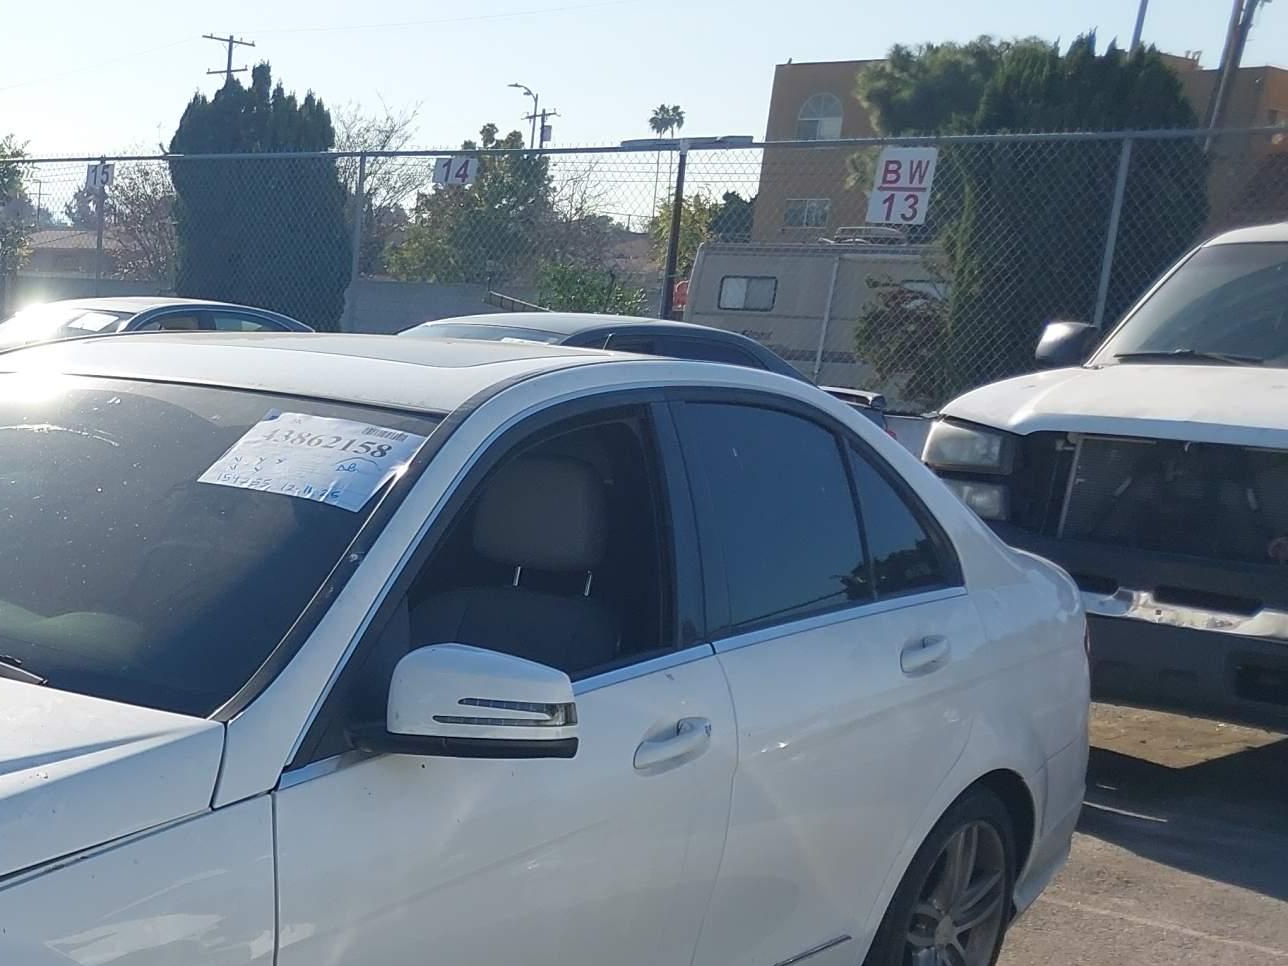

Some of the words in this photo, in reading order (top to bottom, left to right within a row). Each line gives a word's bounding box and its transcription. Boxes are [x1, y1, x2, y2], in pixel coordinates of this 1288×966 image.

[90, 165, 110, 186] 15
[442, 158, 470, 183] 14
[881, 193, 920, 223] 13
[263, 428, 393, 459] 43862158
